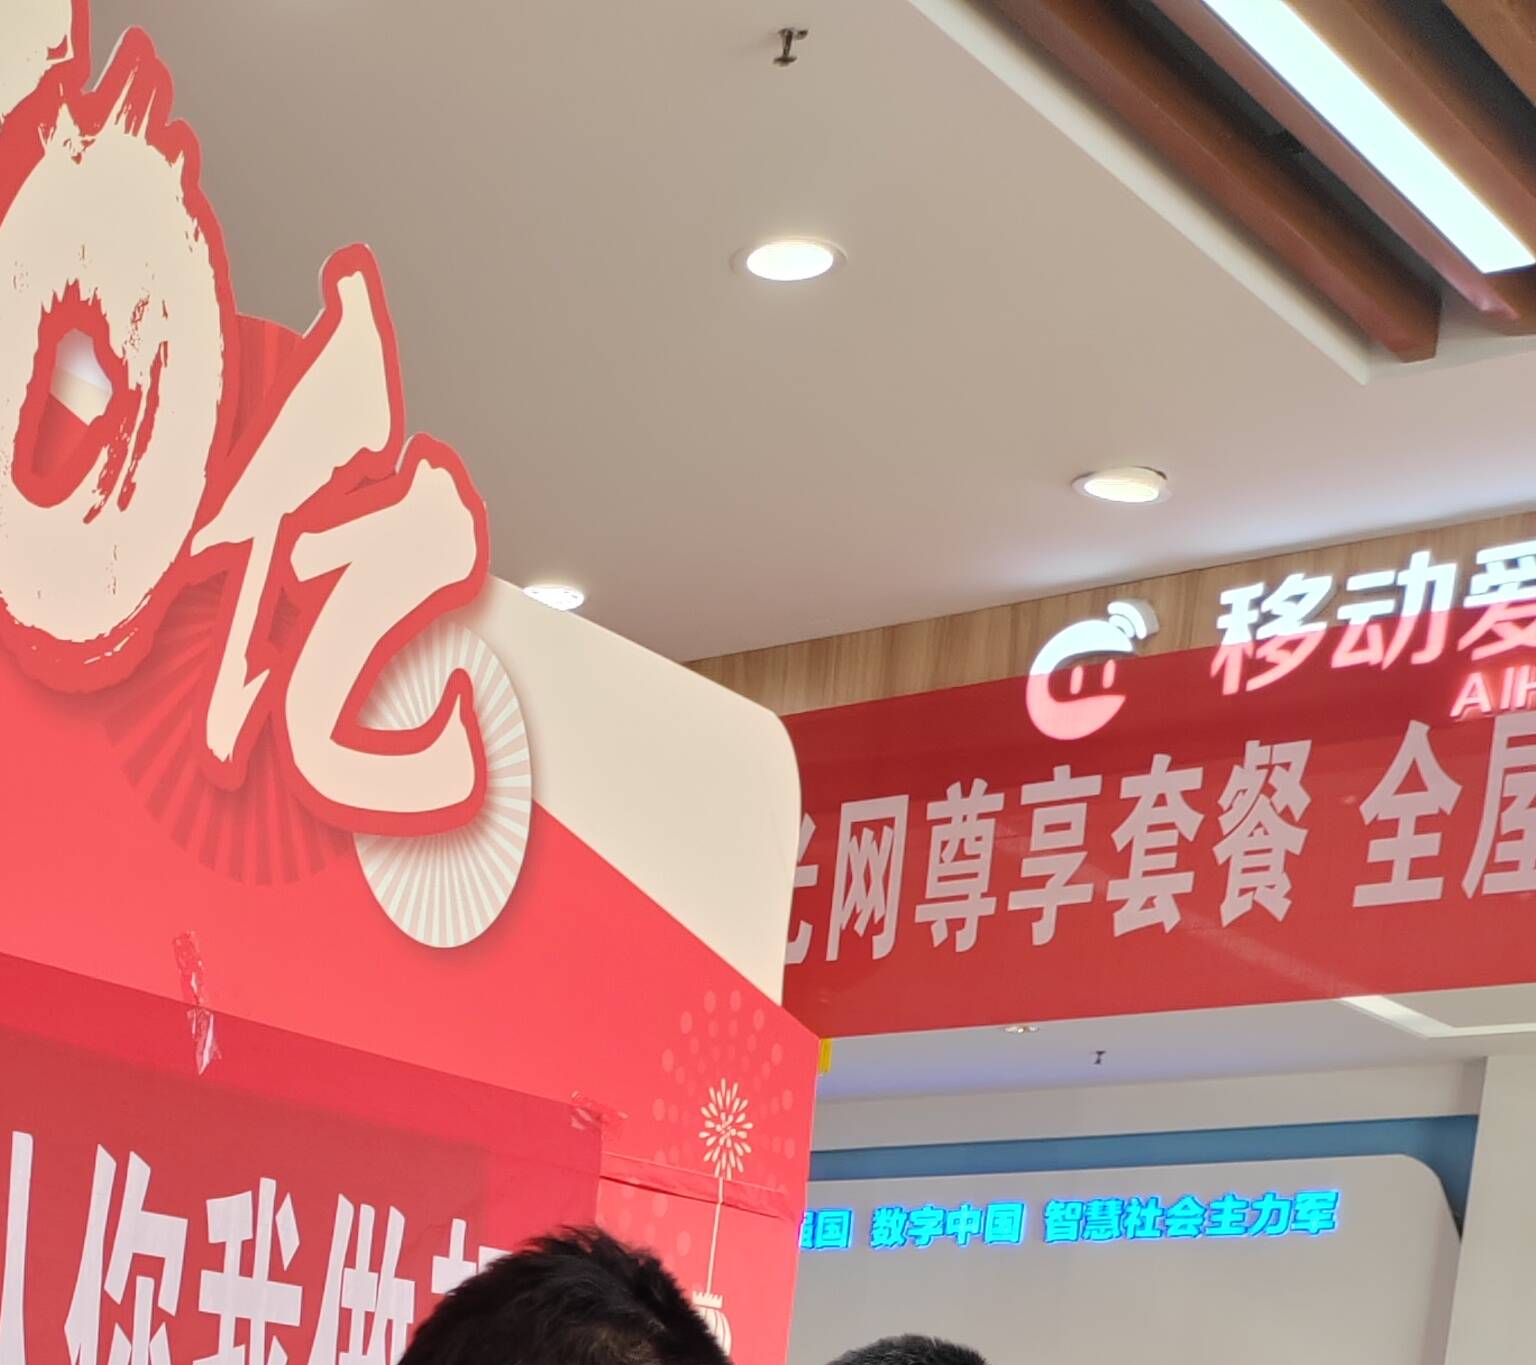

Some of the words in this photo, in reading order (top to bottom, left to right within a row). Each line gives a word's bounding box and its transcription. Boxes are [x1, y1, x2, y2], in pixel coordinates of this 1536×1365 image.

[870, 1202, 1024, 1249] 数字中国
[1043, 1189, 1341, 1243] 智慧社会主力军
